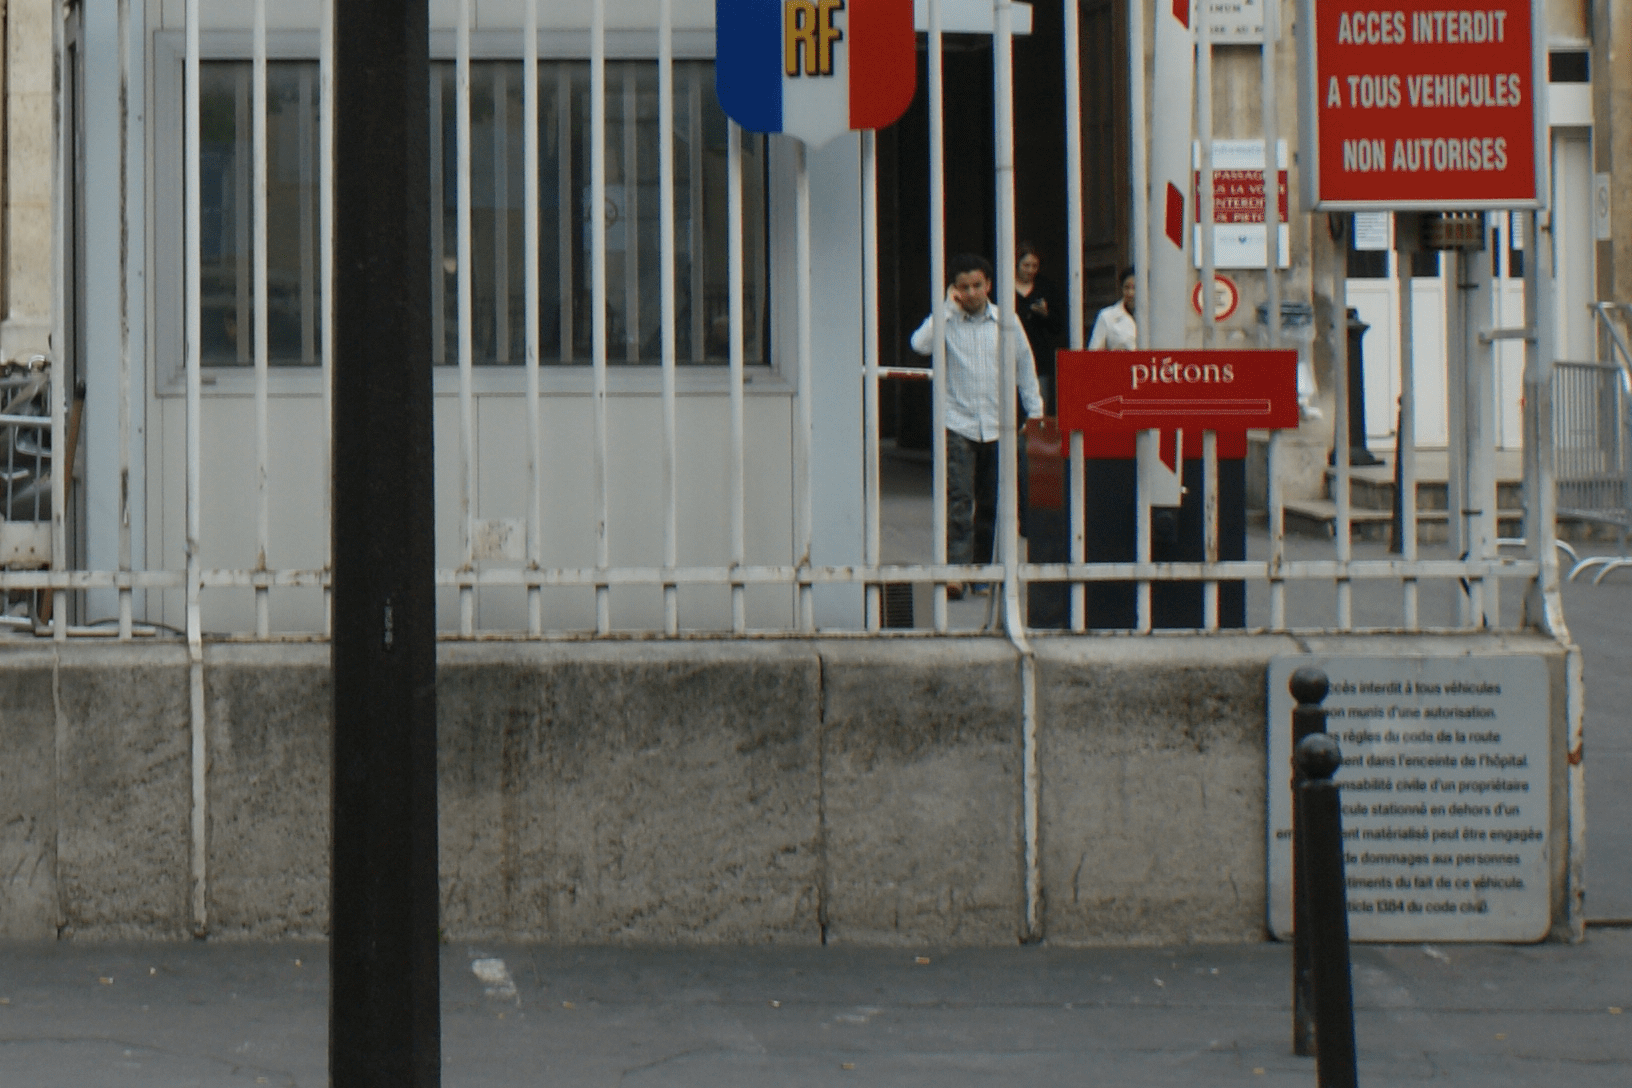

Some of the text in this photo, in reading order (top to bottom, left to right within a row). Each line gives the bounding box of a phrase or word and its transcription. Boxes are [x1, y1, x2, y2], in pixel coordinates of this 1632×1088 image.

[1338, 9, 1507, 45] ACCES INTERDIT
[1327, 73, 1522, 110] A TOUS VEHICULES
[1343, 137, 1508, 173] NON AUTORISES
[1130, 356, 1235, 390] piétons
[1359, 680, 1402, 695] interdit
[1436, 729, 1452, 742] de
[1454, 729, 1465, 742] la
[1468, 730, 1501, 742] route
[1366, 754, 1395, 766] dans
[1460, 754, 1476, 766] de
[1458, 778, 1529, 794] propriétaire
[1370, 802, 1427, 816] stationné
[1430, 806, 1445, 816] en
[1362, 826, 1428, 840] matérialisé
[1431, 827, 1459, 842] peut
[1489, 826, 1543, 843] engagée
[1360, 852, 1429, 866] dommages
[1432, 854, 1453, 864] aux
[1395, 876, 1411, 888] du
[1435, 876, 1452, 888] de
[1455, 878, 1470, 888] ce
[1407, 900, 1422, 913] du
[1425, 900, 1457, 913] code
